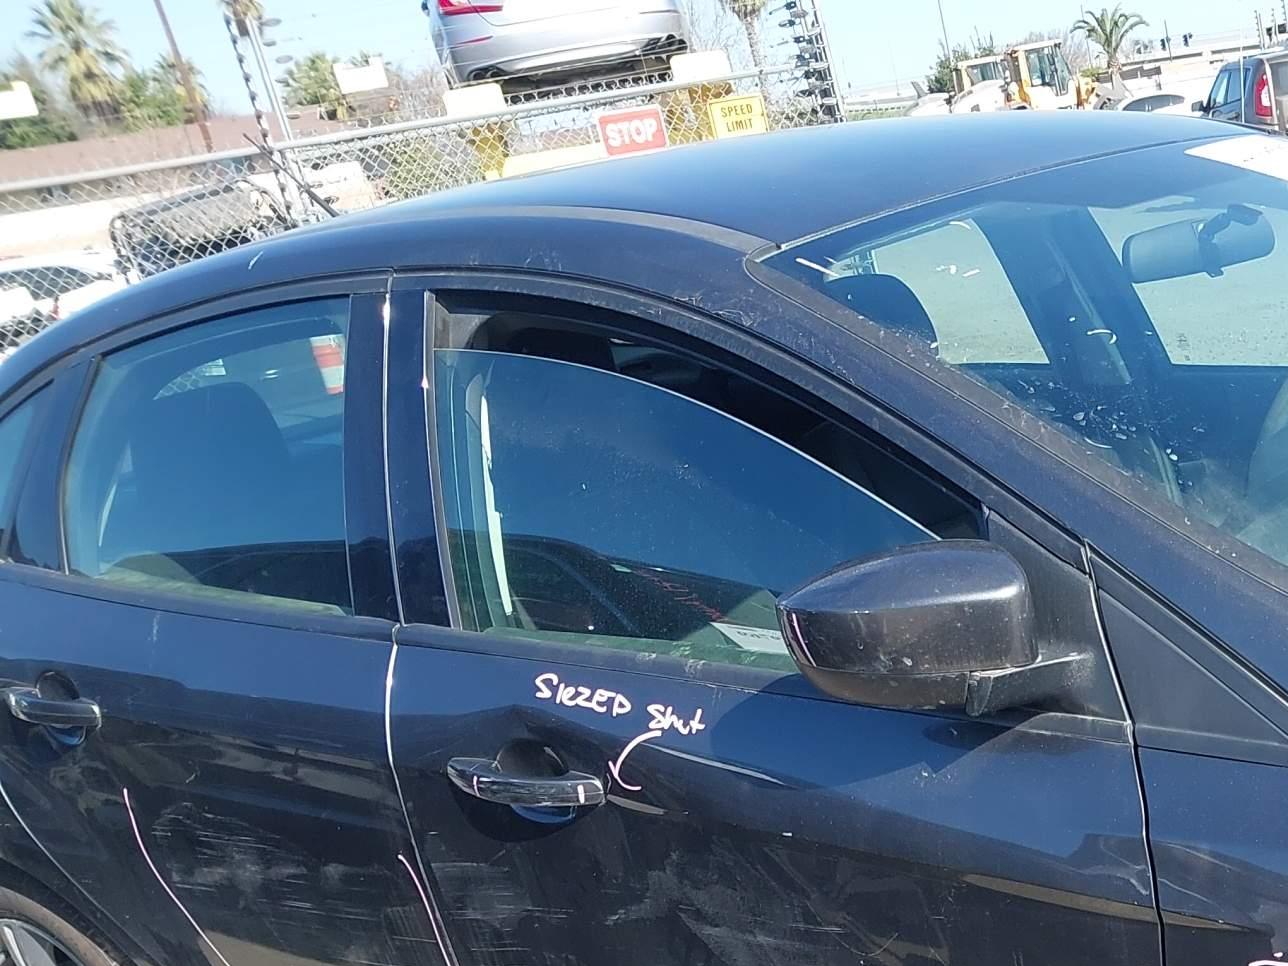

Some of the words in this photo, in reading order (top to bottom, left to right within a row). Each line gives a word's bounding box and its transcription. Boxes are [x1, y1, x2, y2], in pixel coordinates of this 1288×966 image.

[720, 103, 753, 118] SPEED
[605, 118, 658, 147] STOP
[726, 118, 753, 132] LIMIT
[646, 703, 706, 735] Shut
